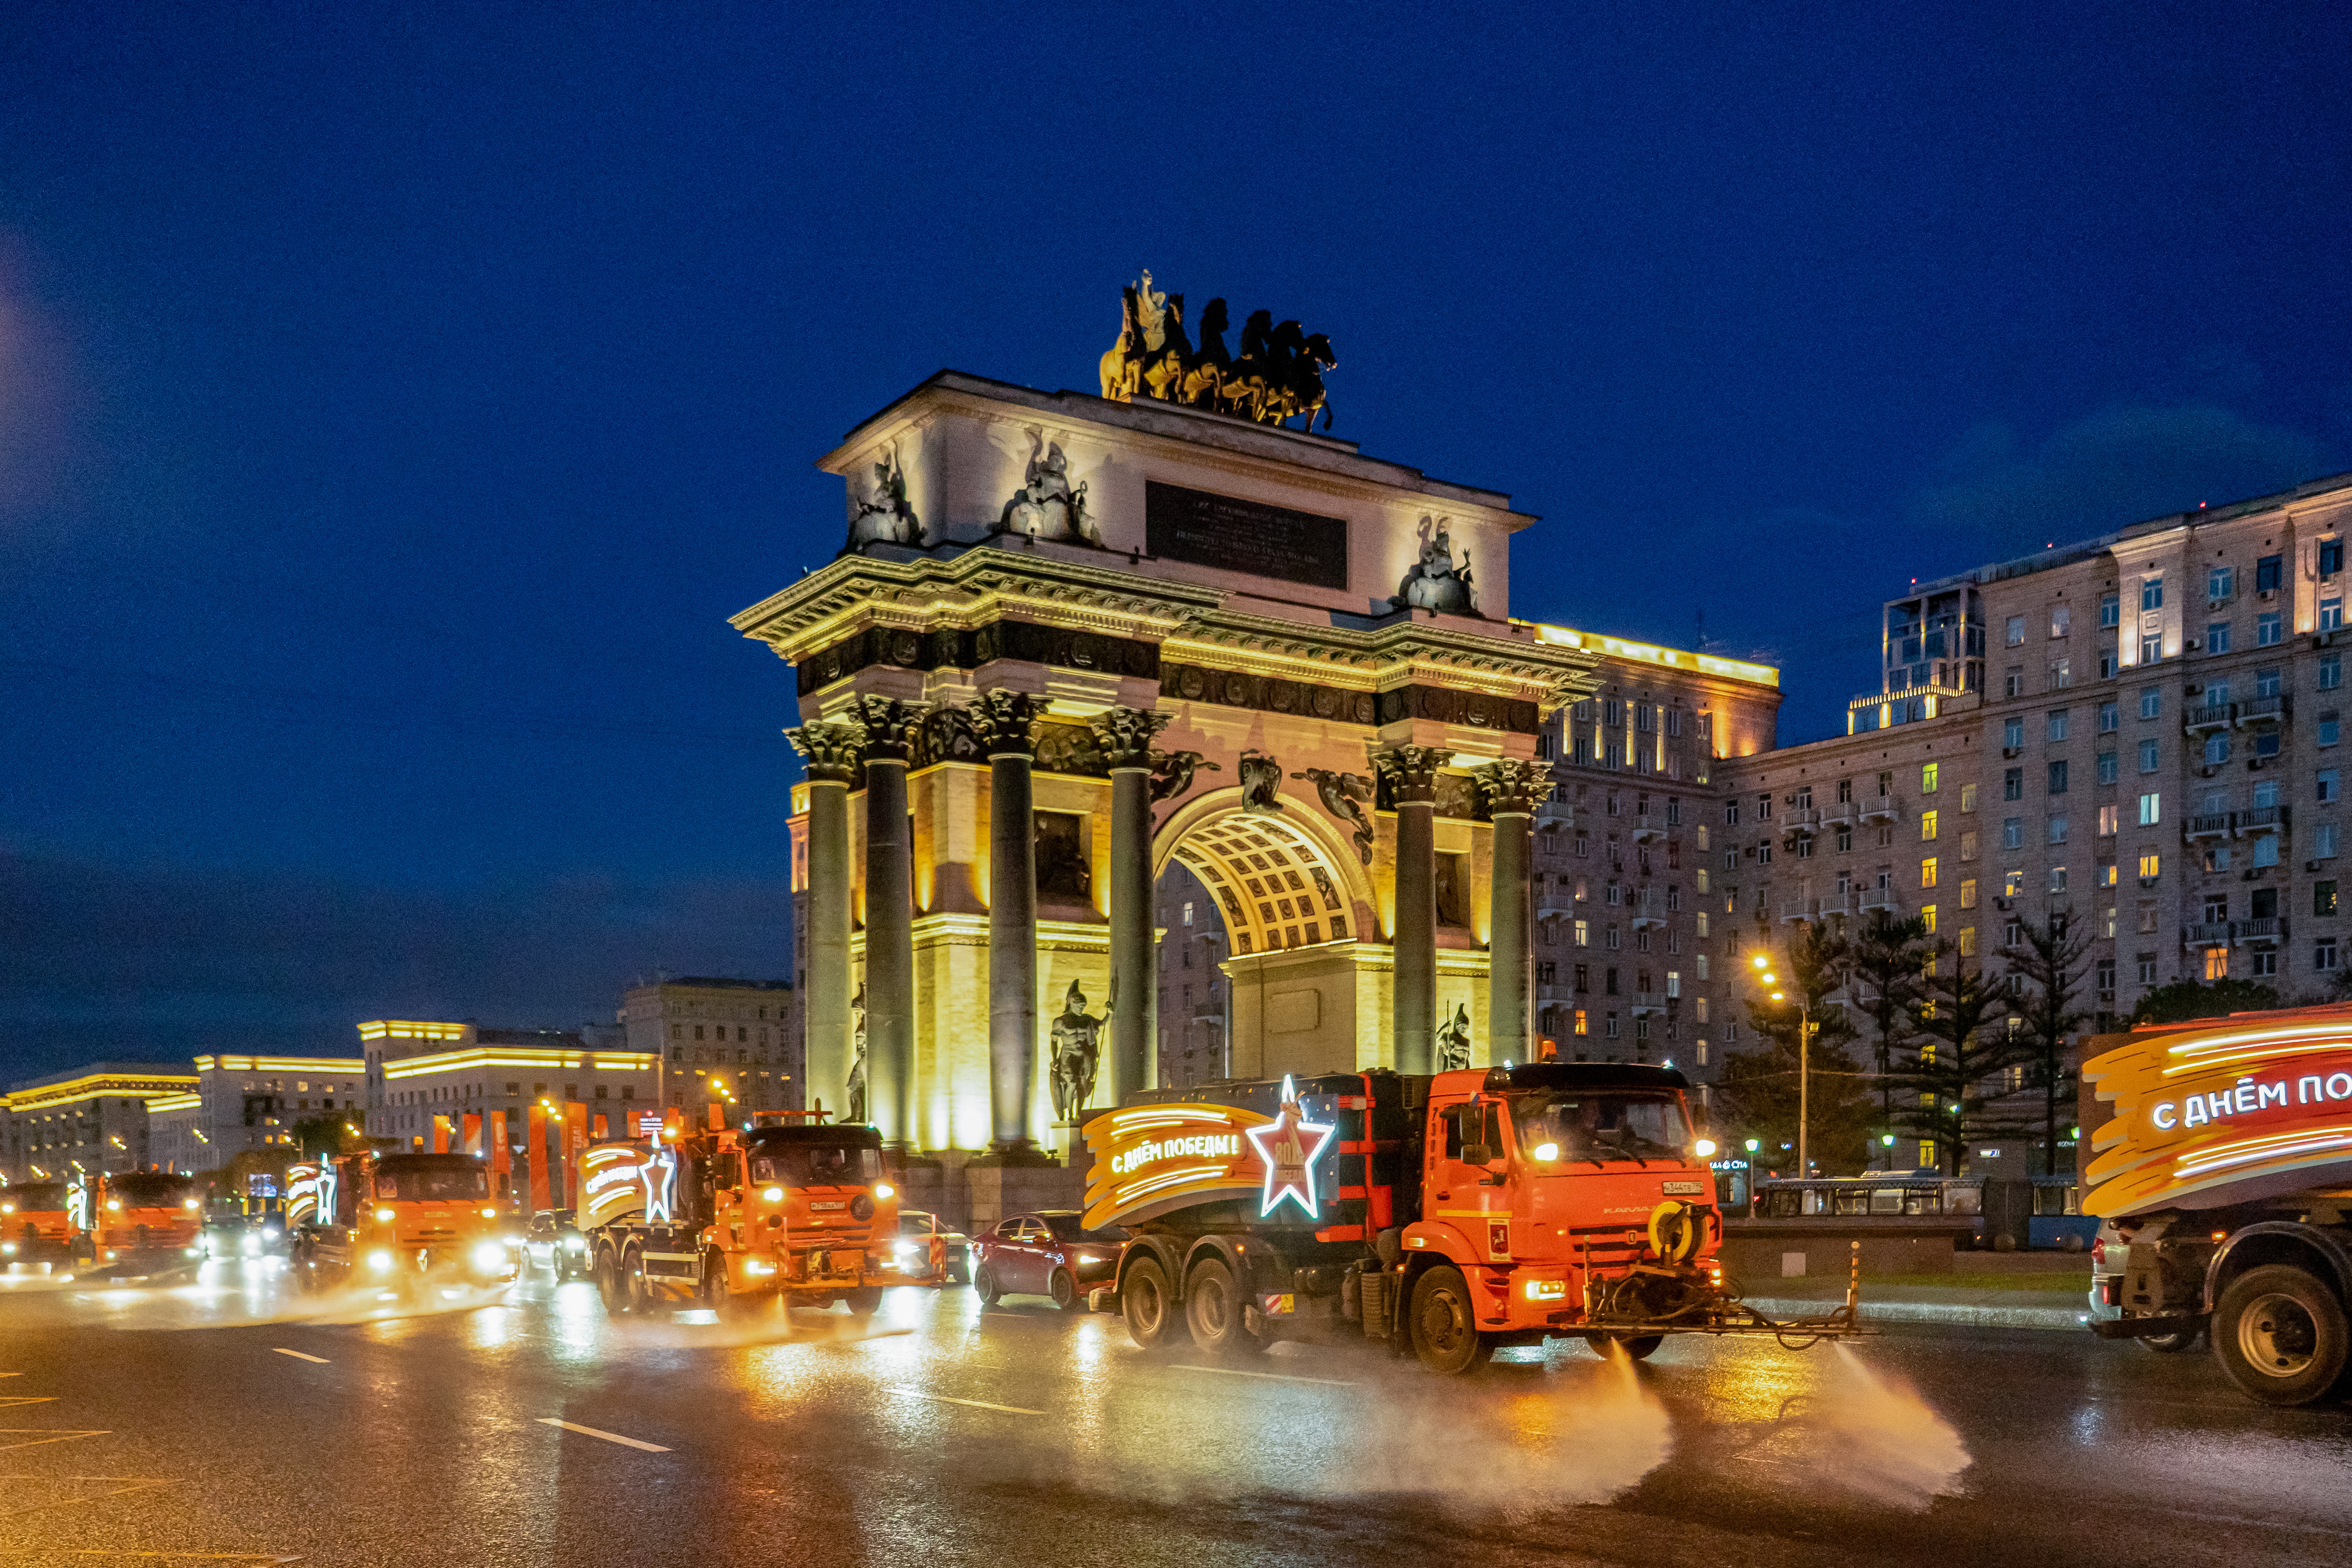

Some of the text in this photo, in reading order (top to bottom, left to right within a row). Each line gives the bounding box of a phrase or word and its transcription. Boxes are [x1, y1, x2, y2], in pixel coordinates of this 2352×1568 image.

[2152, 1103, 2176, 1129] С
[2184, 1077, 2287, 1129] ДНЁМ
[1112, 1134, 1238, 1173] С ДНЁМ ПОБЕДЫ!
[1275, 1142, 1290, 1165] 80
